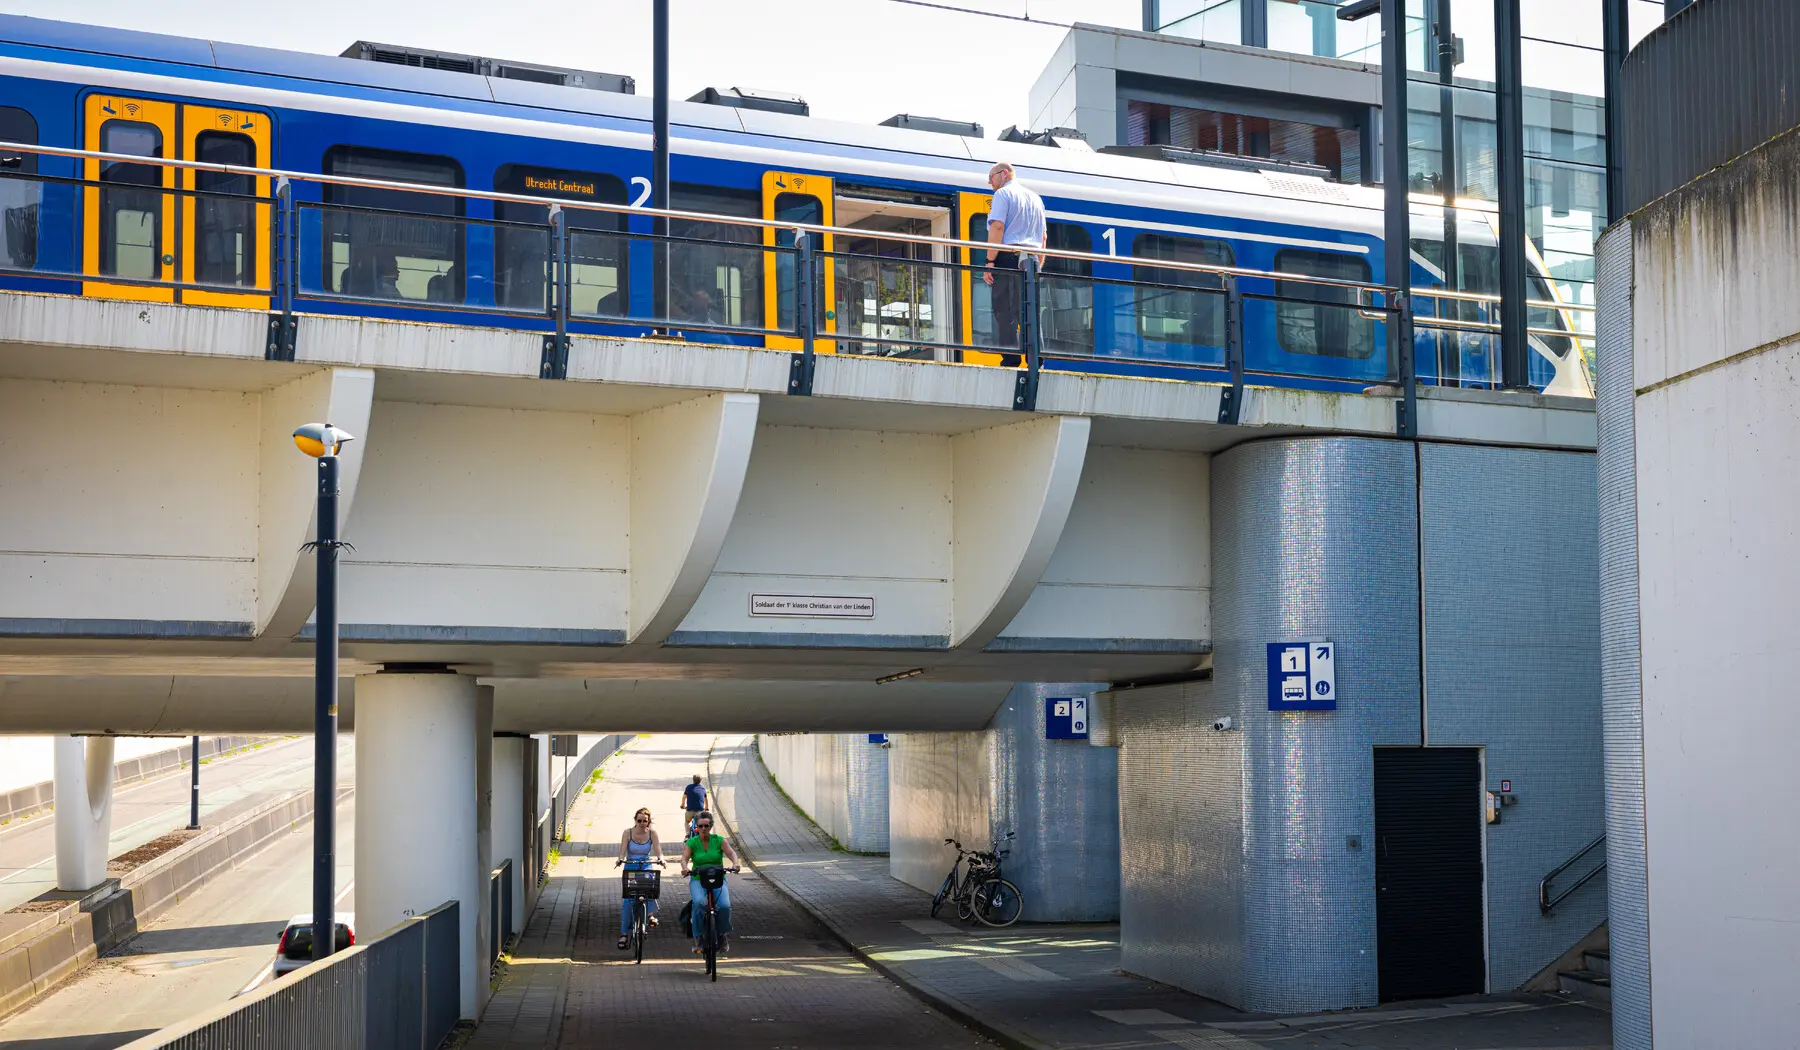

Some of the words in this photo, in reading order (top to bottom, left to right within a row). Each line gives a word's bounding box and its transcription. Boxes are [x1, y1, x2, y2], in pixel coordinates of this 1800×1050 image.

[525, 176, 556, 189] Utrecht
[559, 180, 594, 194] Centraal
[630, 176, 652, 208] 2
[1101, 227, 1116, 257] 1
[1290, 656, 1296, 670] 1
[1059, 706, 1065, 715] 2
